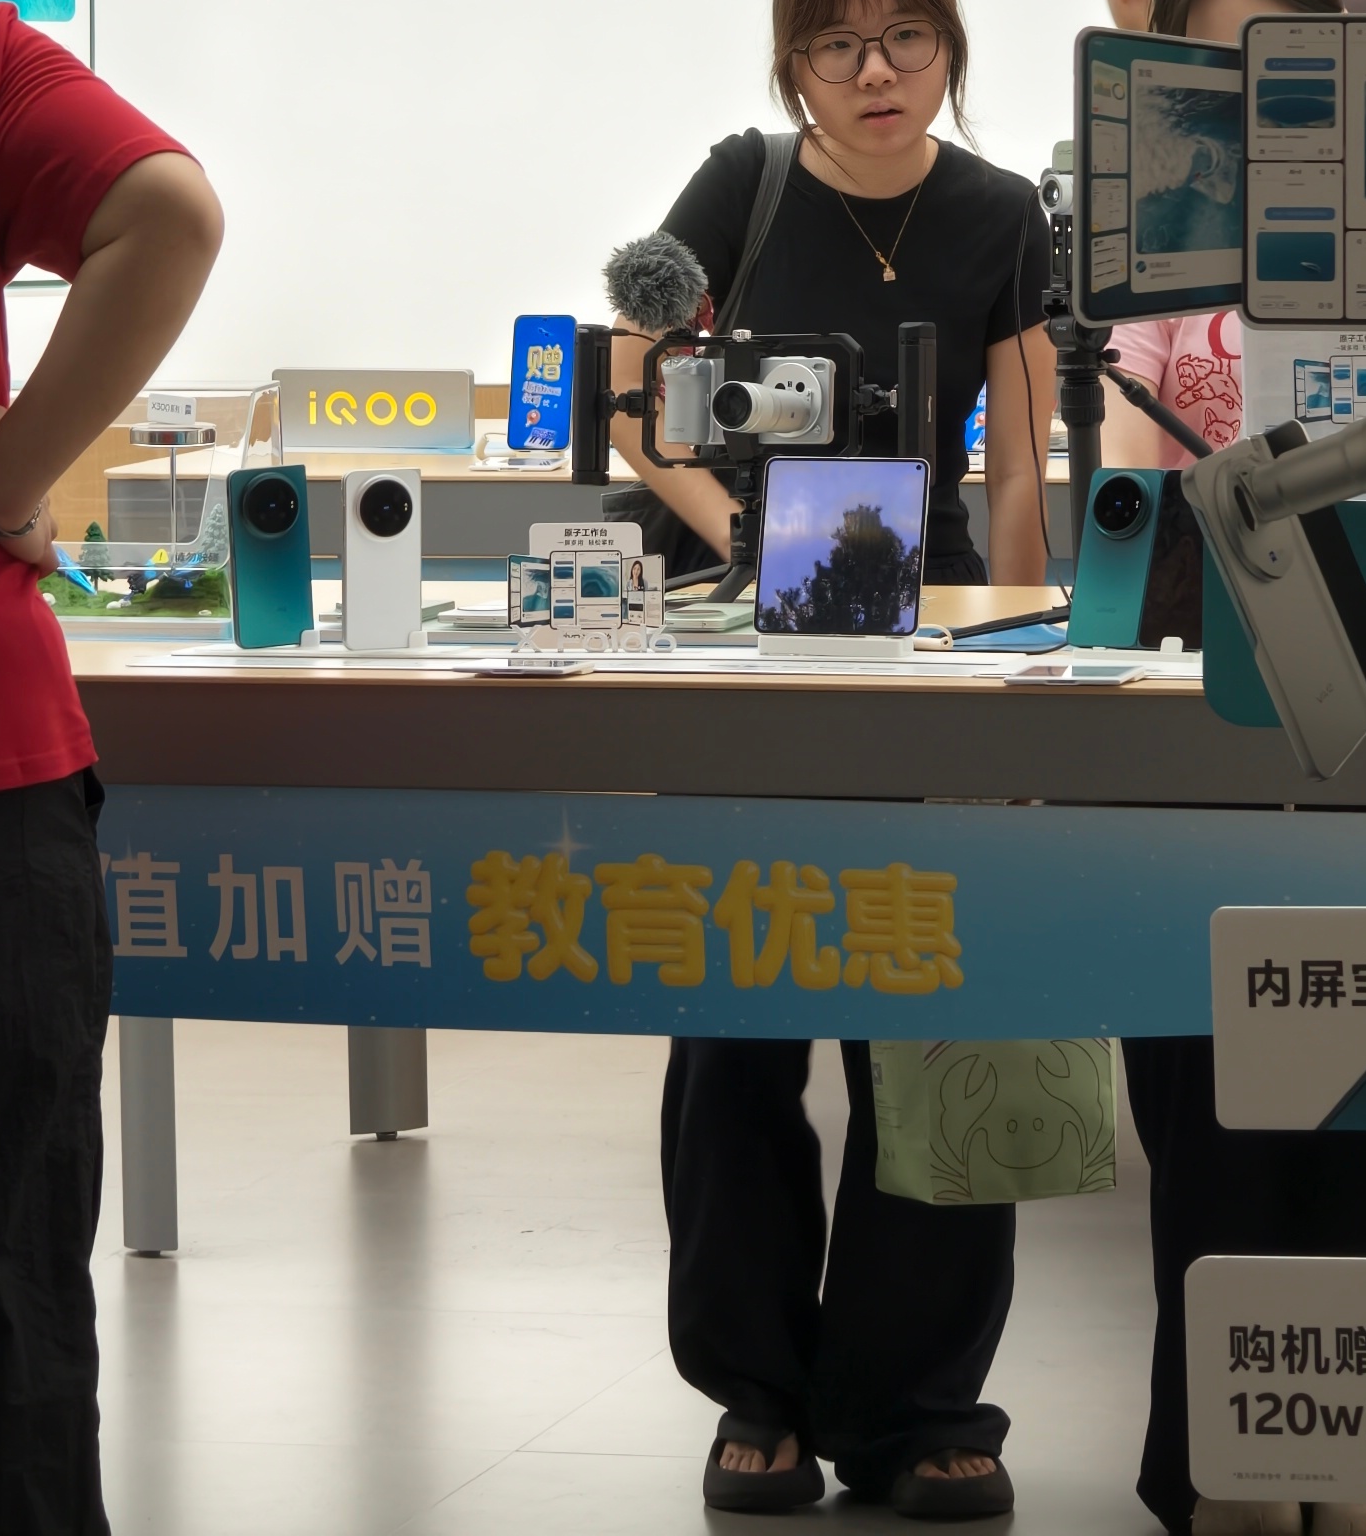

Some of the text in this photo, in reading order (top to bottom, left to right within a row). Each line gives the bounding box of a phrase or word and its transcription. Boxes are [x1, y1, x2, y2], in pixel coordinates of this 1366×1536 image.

[525, 344, 563, 382] 赠
[308, 390, 437, 426] iQOO
[564, 528, 608, 537] 原子工作台
[510, 623, 677, 653] X Fold6
[466, 850, 964, 995] 教育优惠
